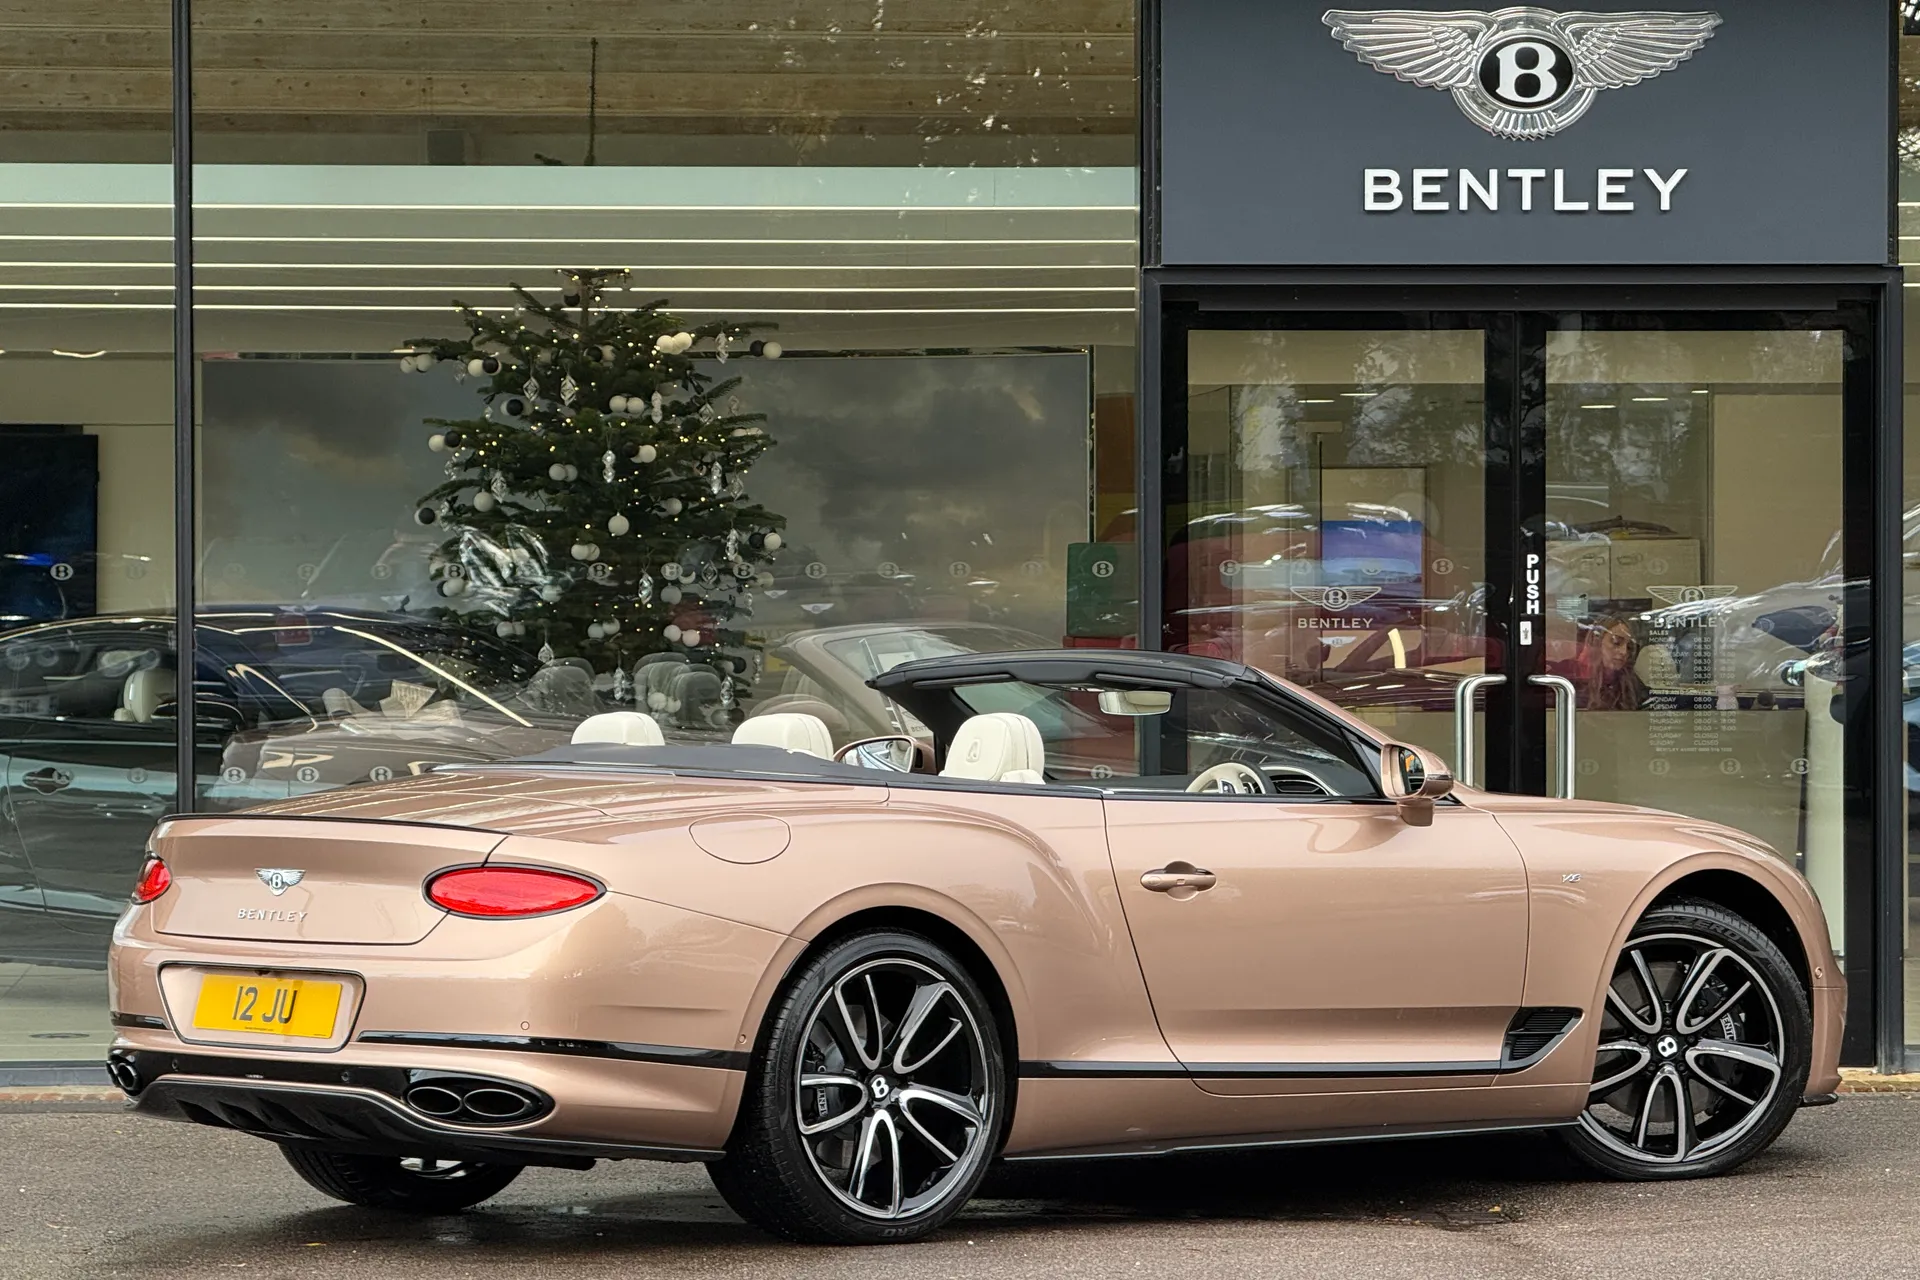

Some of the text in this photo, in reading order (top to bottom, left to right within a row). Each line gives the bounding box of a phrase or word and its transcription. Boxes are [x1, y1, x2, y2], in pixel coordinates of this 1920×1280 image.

[1496, 41, 1558, 102] B
[1364, 168, 1688, 211] BENTLEY
[1526, 554, 1539, 615] PUSH
[1328, 590, 1342, 604] B
[1298, 618, 1373, 629] BENTLEY
[1654, 616, 1729, 628] BENTLEY
[1562, 873, 1582, 883] V8
[237, 908, 308, 922] BENTLEY
[232, 986, 298, 1024] 12 JU
[1658, 1037, 1677, 1057] B
[870, 1076, 890, 1099] B
